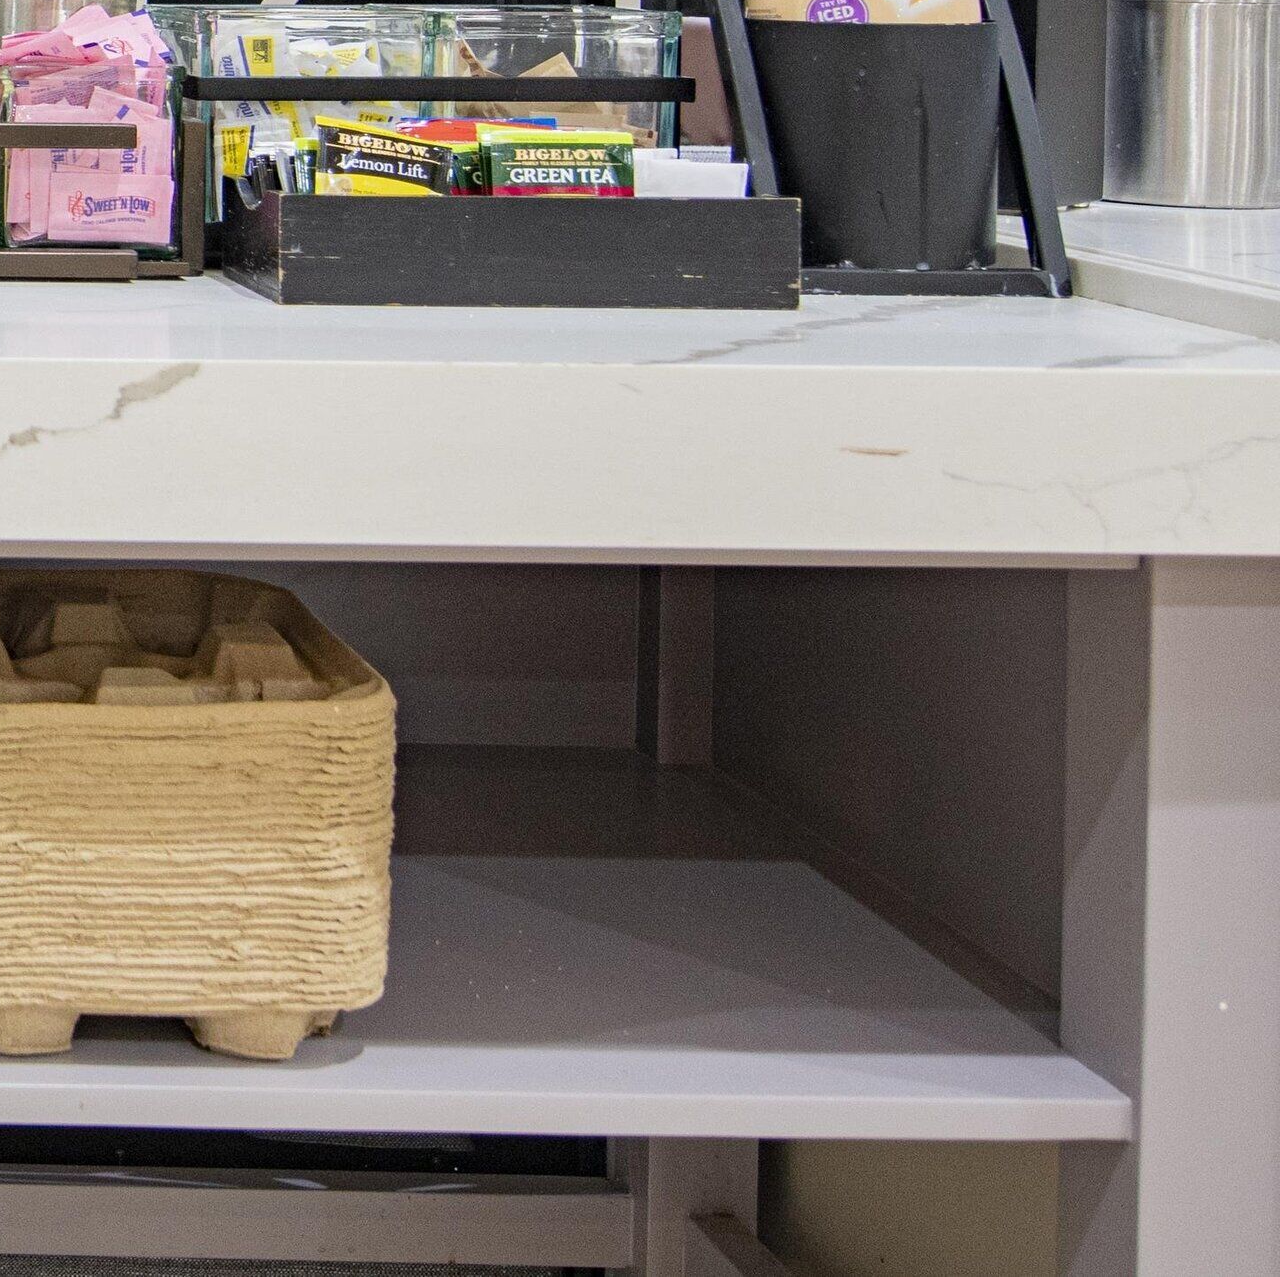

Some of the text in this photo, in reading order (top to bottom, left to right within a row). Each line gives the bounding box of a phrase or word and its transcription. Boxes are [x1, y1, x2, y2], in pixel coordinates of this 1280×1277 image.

[817, 5, 855, 22] ICED
[338, 132, 426, 157] BIGELOW
[337, 153, 394, 173] Lemon
[514, 148, 606, 161] BIGELOW
[510, 168, 615, 184] GREEN TEA
[129, 195, 150, 214] LOW
